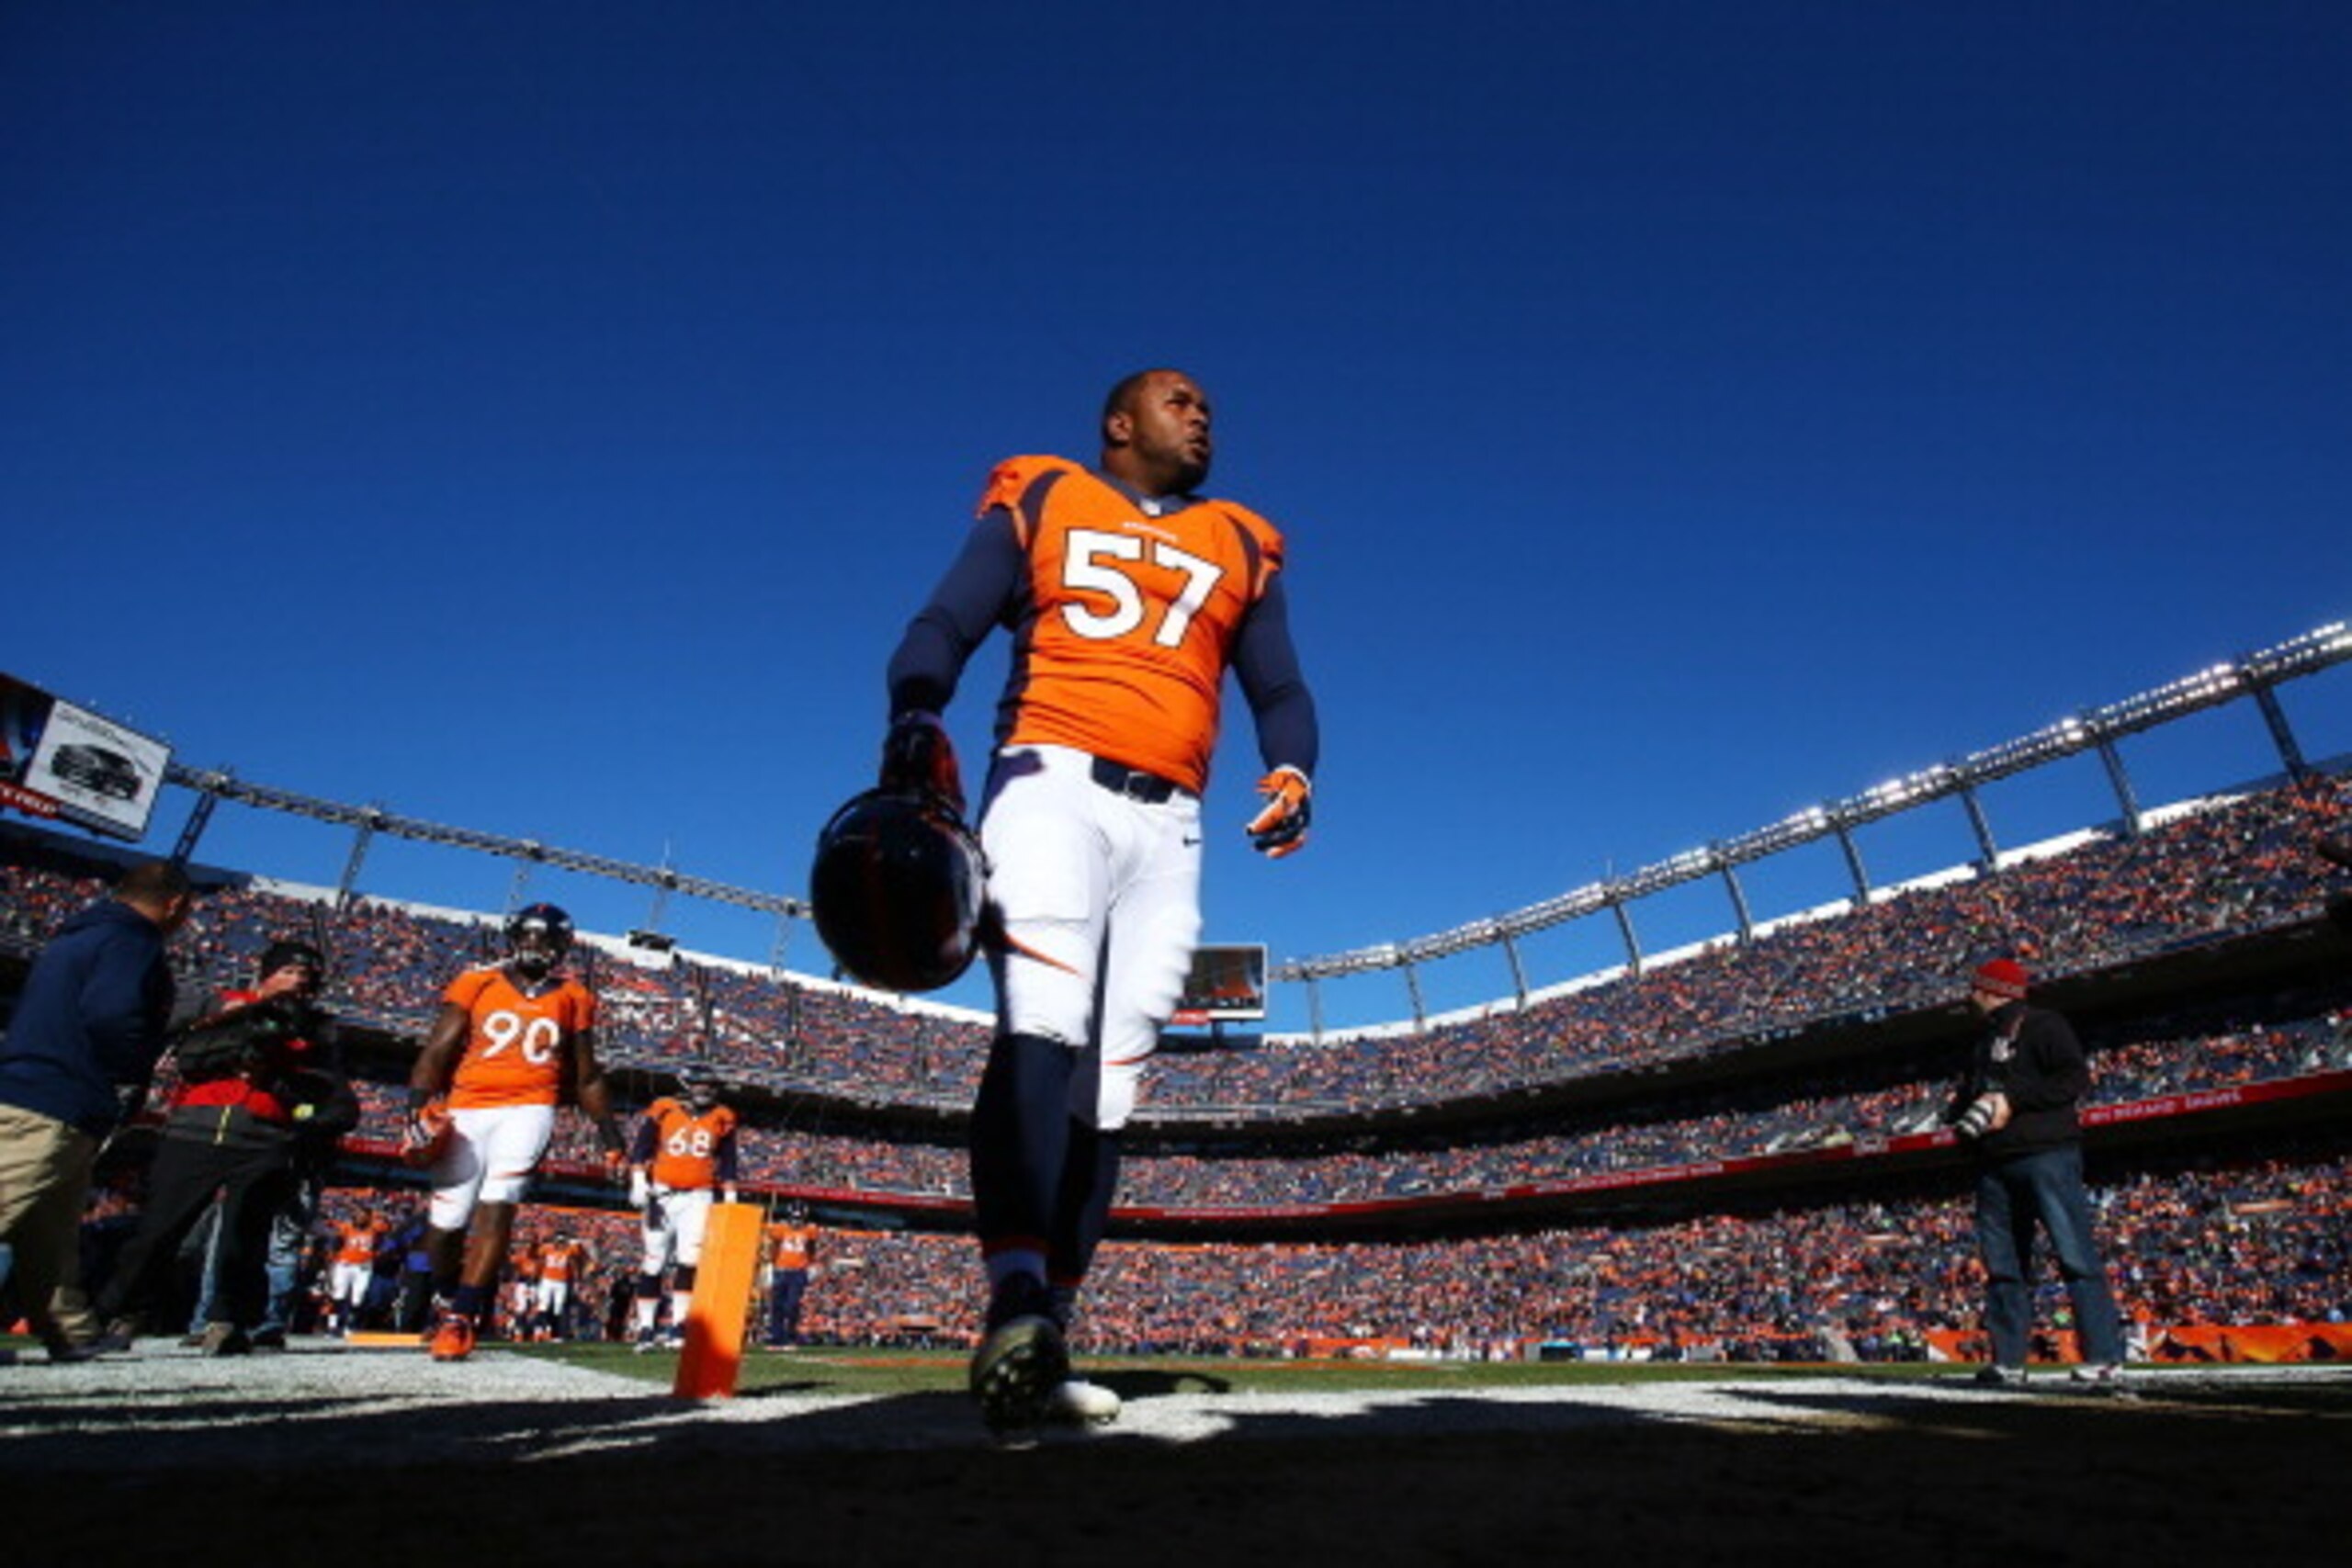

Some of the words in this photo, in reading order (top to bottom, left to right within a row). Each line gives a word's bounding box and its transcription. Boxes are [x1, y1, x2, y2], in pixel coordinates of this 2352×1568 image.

[1060, 528, 1227, 649] 57
[482, 1010, 559, 1064] 90
[667, 1127, 711, 1158] 68
